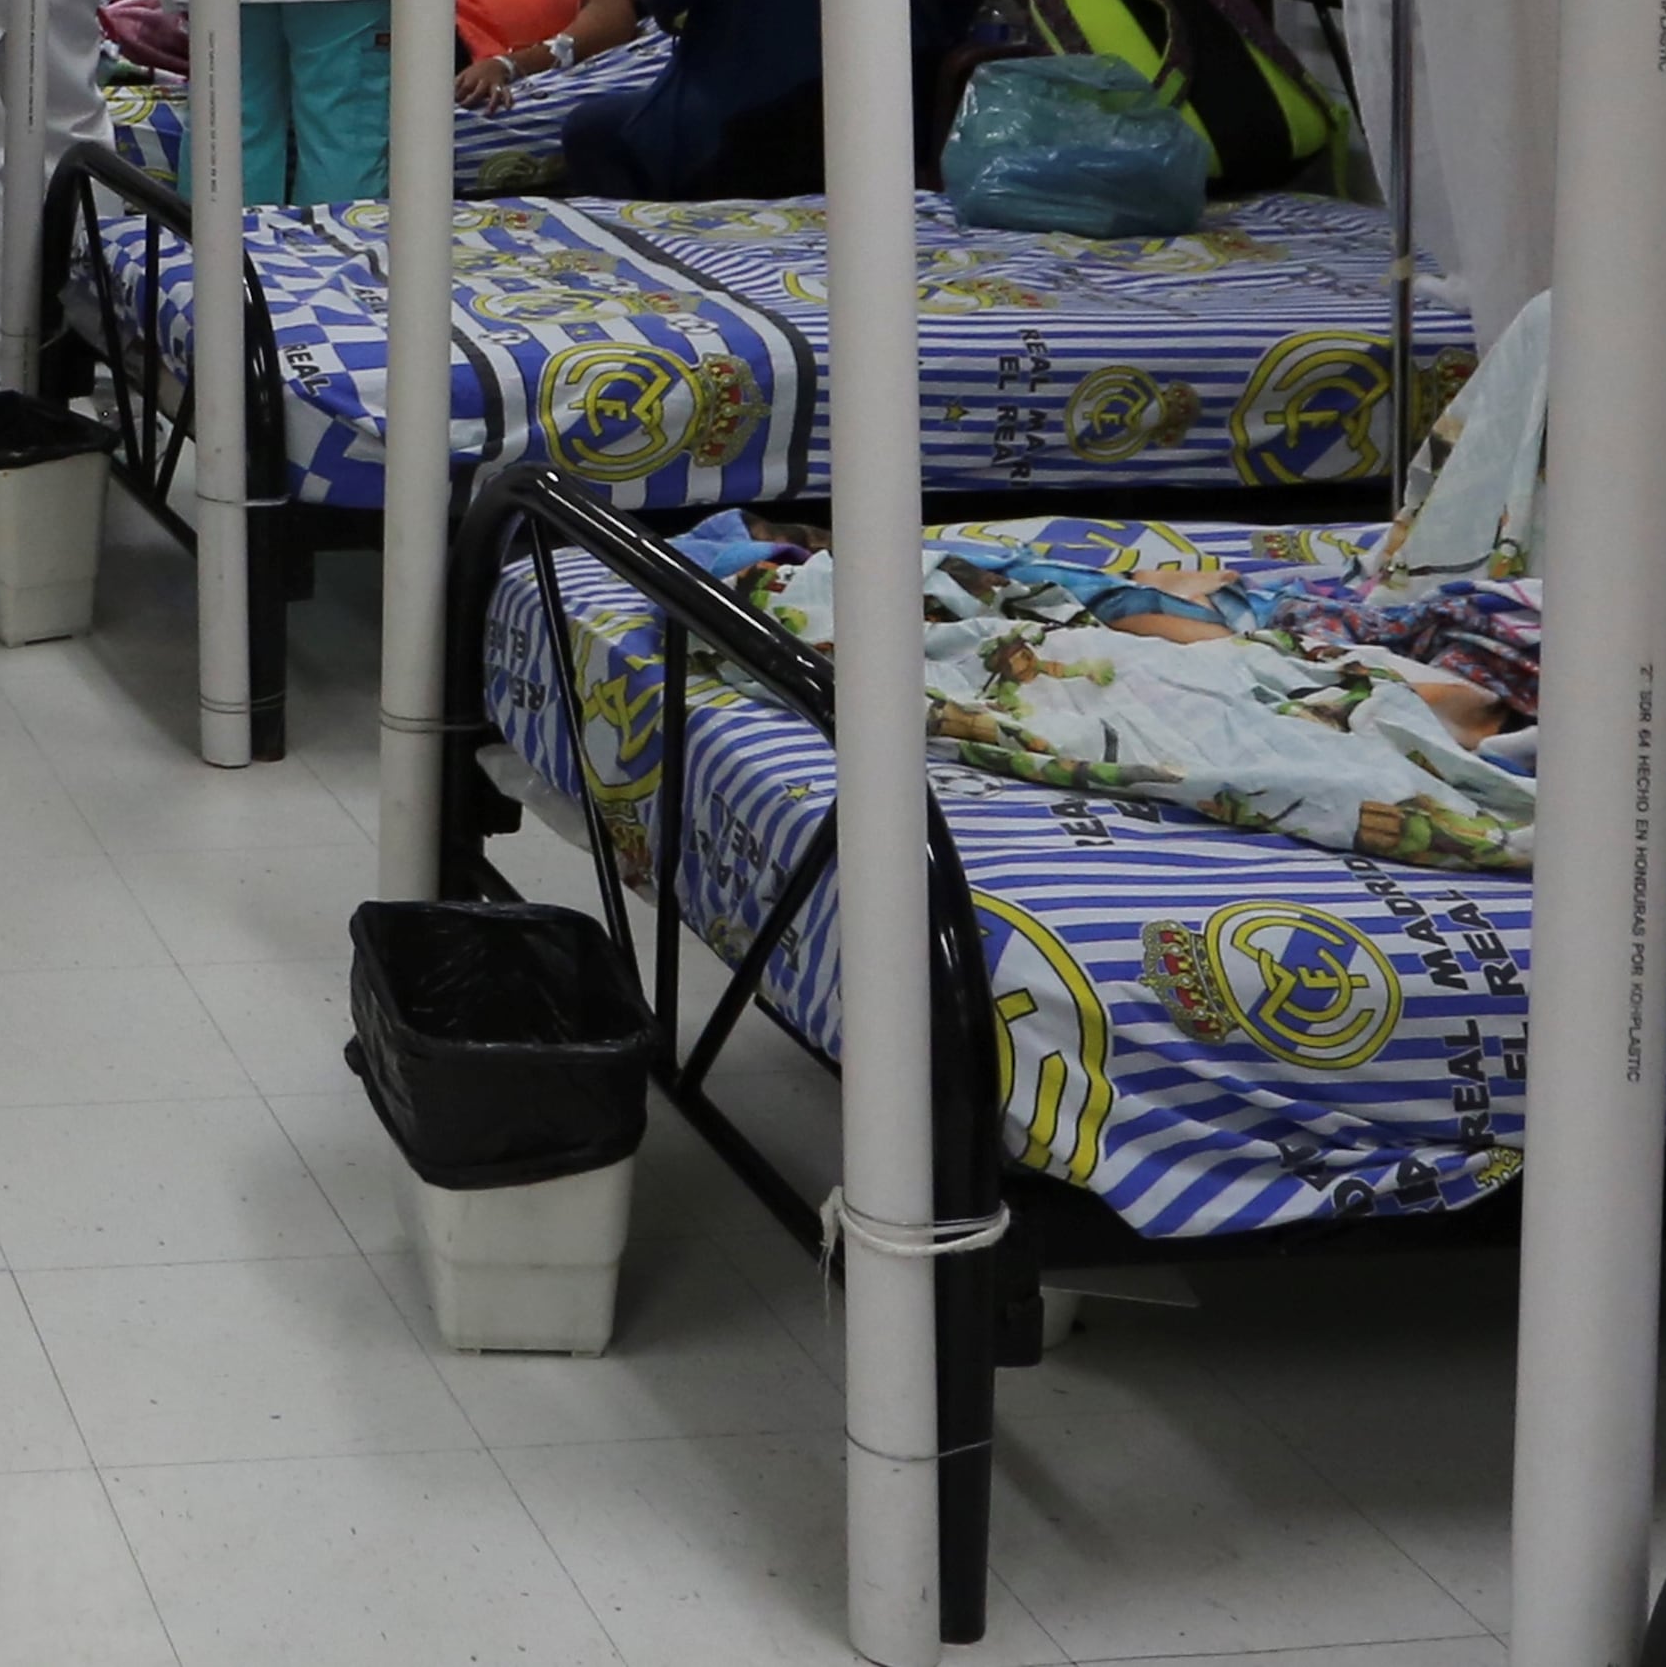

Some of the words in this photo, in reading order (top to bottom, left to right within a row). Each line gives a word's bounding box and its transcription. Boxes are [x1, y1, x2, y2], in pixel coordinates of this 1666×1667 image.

[285, 344, 330, 395] REAL
[999, 356, 1020, 390] EL
[1019, 328, 1052, 392] REAL
[991, 406, 1019, 467] REA
[1636, 755, 1651, 812] HECHO
[1635, 819, 1650, 840] EN
[1632, 846, 1649, 936] HONDURAS
[1344, 858, 1469, 990] MADRID
[1435, 890, 1525, 996] REAL
[1631, 942, 1645, 976] POR
[1444, 1018, 1495, 1147] REAL
